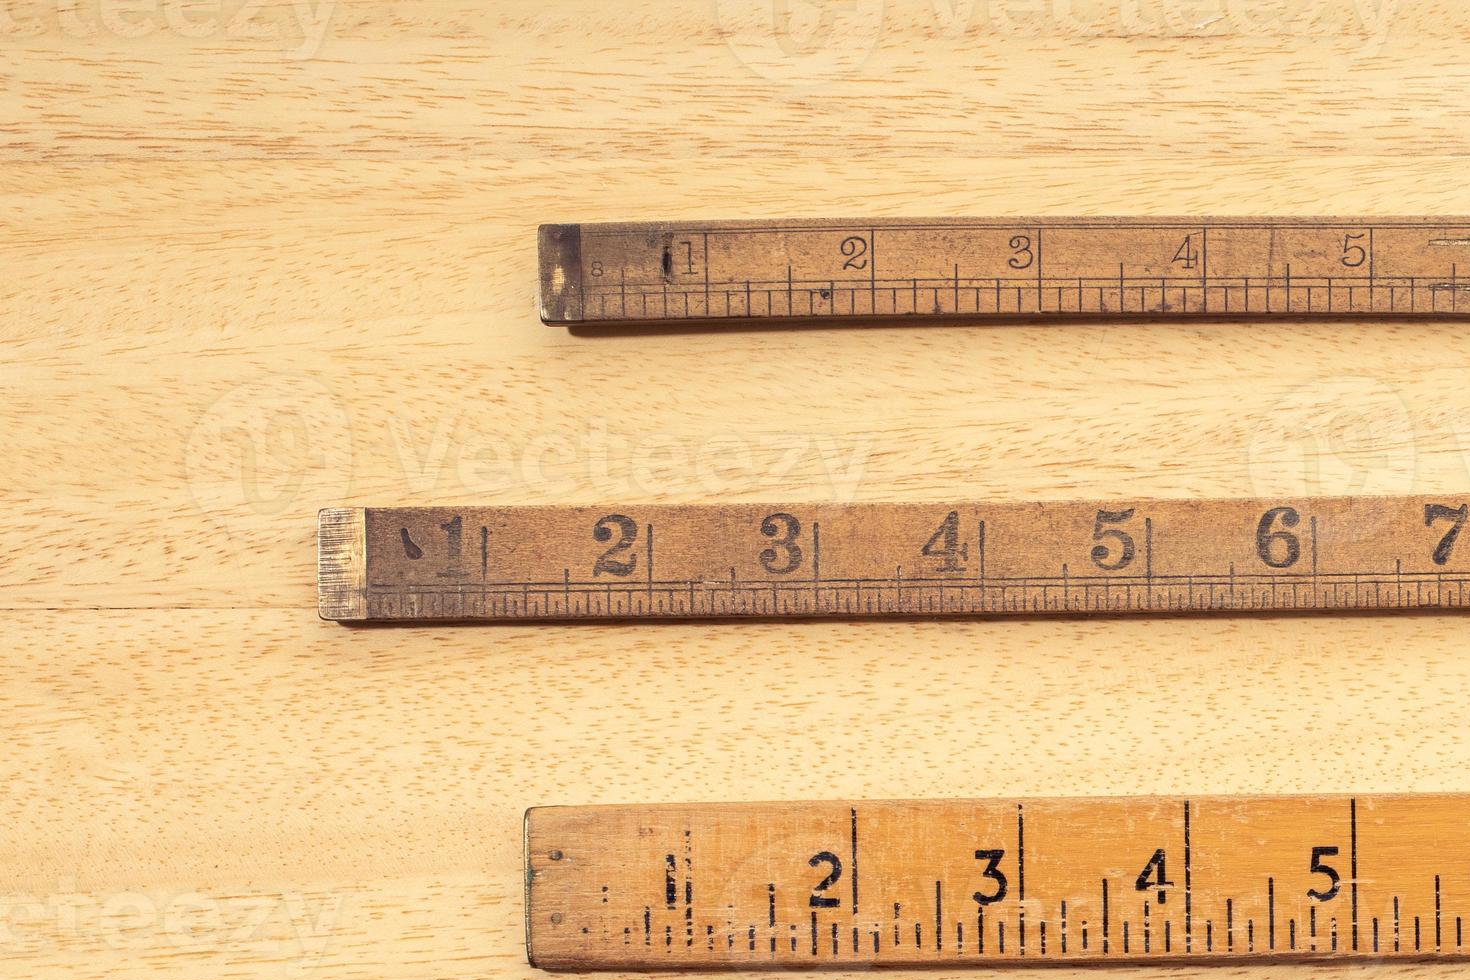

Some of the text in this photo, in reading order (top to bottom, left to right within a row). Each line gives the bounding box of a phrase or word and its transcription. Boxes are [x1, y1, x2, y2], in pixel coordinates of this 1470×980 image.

[591, 261, 604, 278] 8
[679, 241, 699, 275] 1
[839, 235, 868, 271] 2
[1008, 235, 1034, 270] 3
[1171, 234, 1199, 270] 4
[1341, 233, 1366, 267] 5
[440, 515, 468, 577] 1
[593, 514, 638, 576] 2
[760, 513, 801, 574] 3
[920, 510, 969, 573] 4
[1090, 508, 1136, 570] 5
[1256, 506, 1301, 568] 6
[1424, 502, 1469, 565] 7
[807, 850, 843, 909] 2
[973, 848, 1008, 906] 3
[1135, 848, 1175, 905] 4
[1307, 846, 1340, 902] 5
